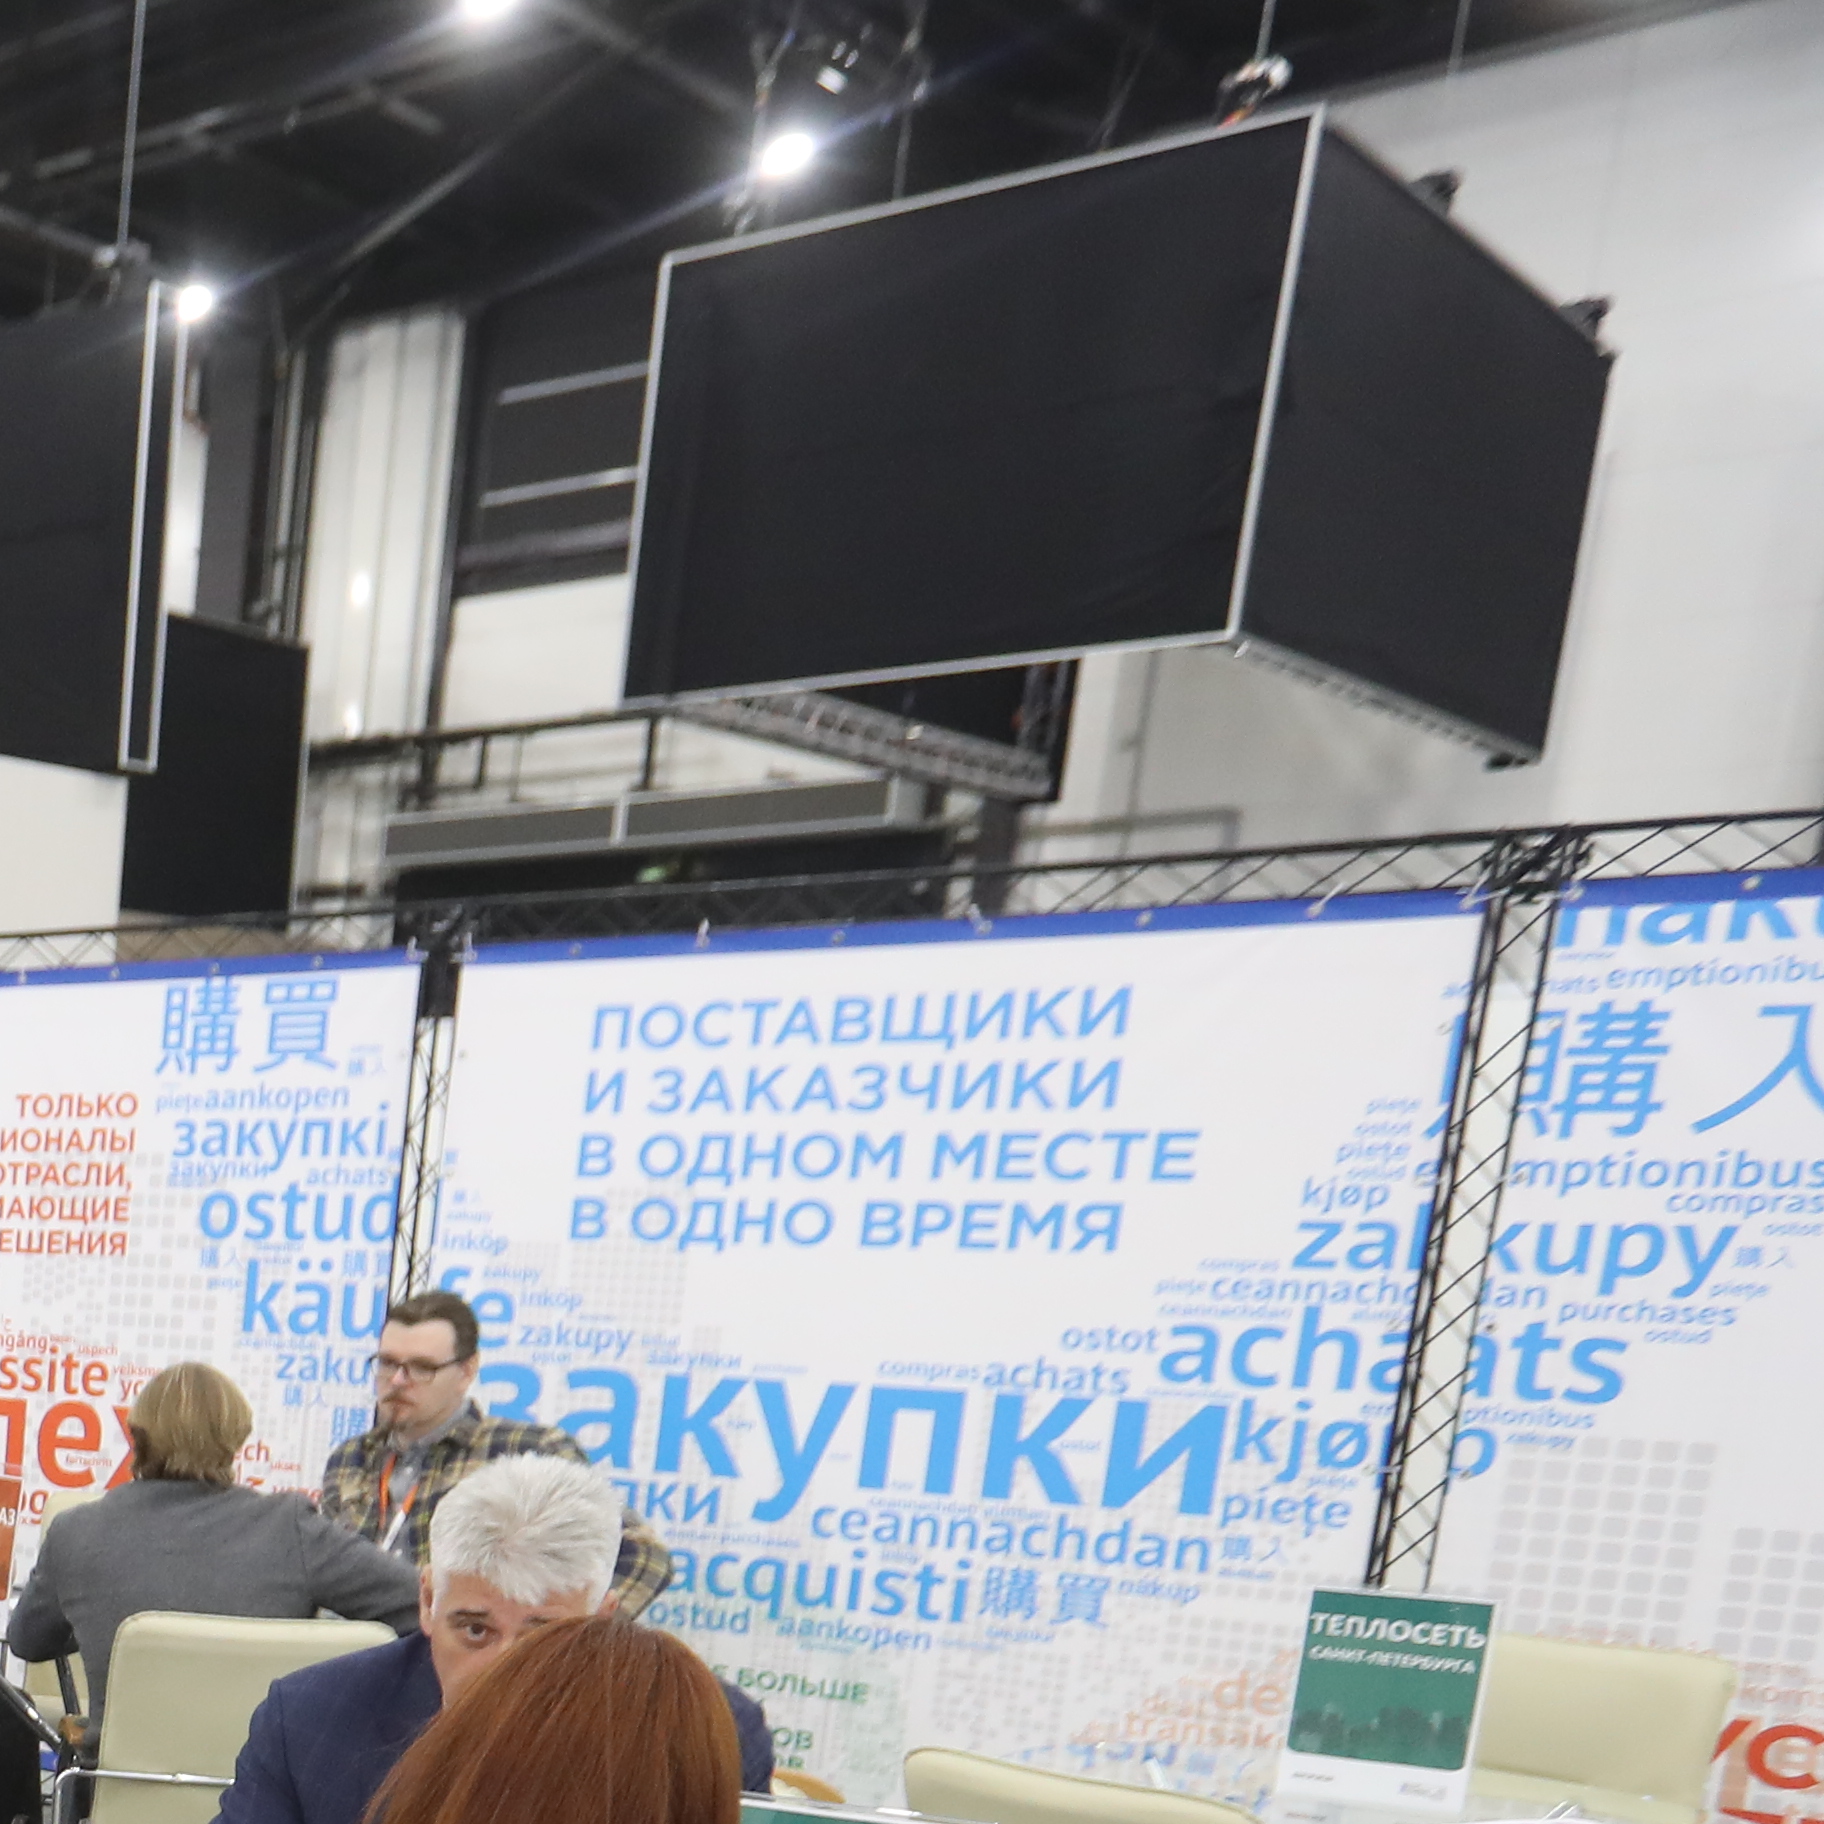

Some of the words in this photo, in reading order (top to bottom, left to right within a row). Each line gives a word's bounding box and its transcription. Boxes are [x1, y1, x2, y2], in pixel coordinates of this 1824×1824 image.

[154, 975, 340, 1076] 購買
[592, 984, 1135, 1052] ПОСТАВЩИКИ
[16, 1092, 139, 1118] ТОЛЬКО
[204, 1081, 351, 1113] aankopen
[583, 1069, 626, 1114] И
[647, 1058, 1125, 1115] ЗАКАЗЧИКИ
[576, 1132, 617, 1178] В
[637, 1130, 906, 1188] ОДНОМ
[929, 1129, 1204, 1184] МЕСТЕ
[1301, 1175, 1392, 1215] kjøp
[440, 1229, 509, 1256] inköp
[568, 1196, 608, 1242] В
[630, 1197, 837, 1252] ОДНО
[859, 1200, 1125, 1253] ВРЕМЯ
[520, 1286, 584, 1312] inköp
[1556, 1297, 1739, 1328] purchases
[517, 1319, 636, 1359] zakupy
[1060, 1324, 1159, 1354] ostot
[877, 1357, 980, 1381] compras
[982, 1355, 1132, 1397] achats
[811, 1502, 1213, 1574] ceannachdan
[667, 1547, 972, 1625] acquisti
[648, 1600, 754, 1636] ostud
[777, 1614, 934, 1653] aankopen
[1309, 1610, 1487, 1650] ТЕПЛОСЕТЬ
[1307, 1644, 1476, 1675] САНКТ-ПЕТЕРБУРГА
[734, 1665, 871, 1703] БОЛЬШЕ
